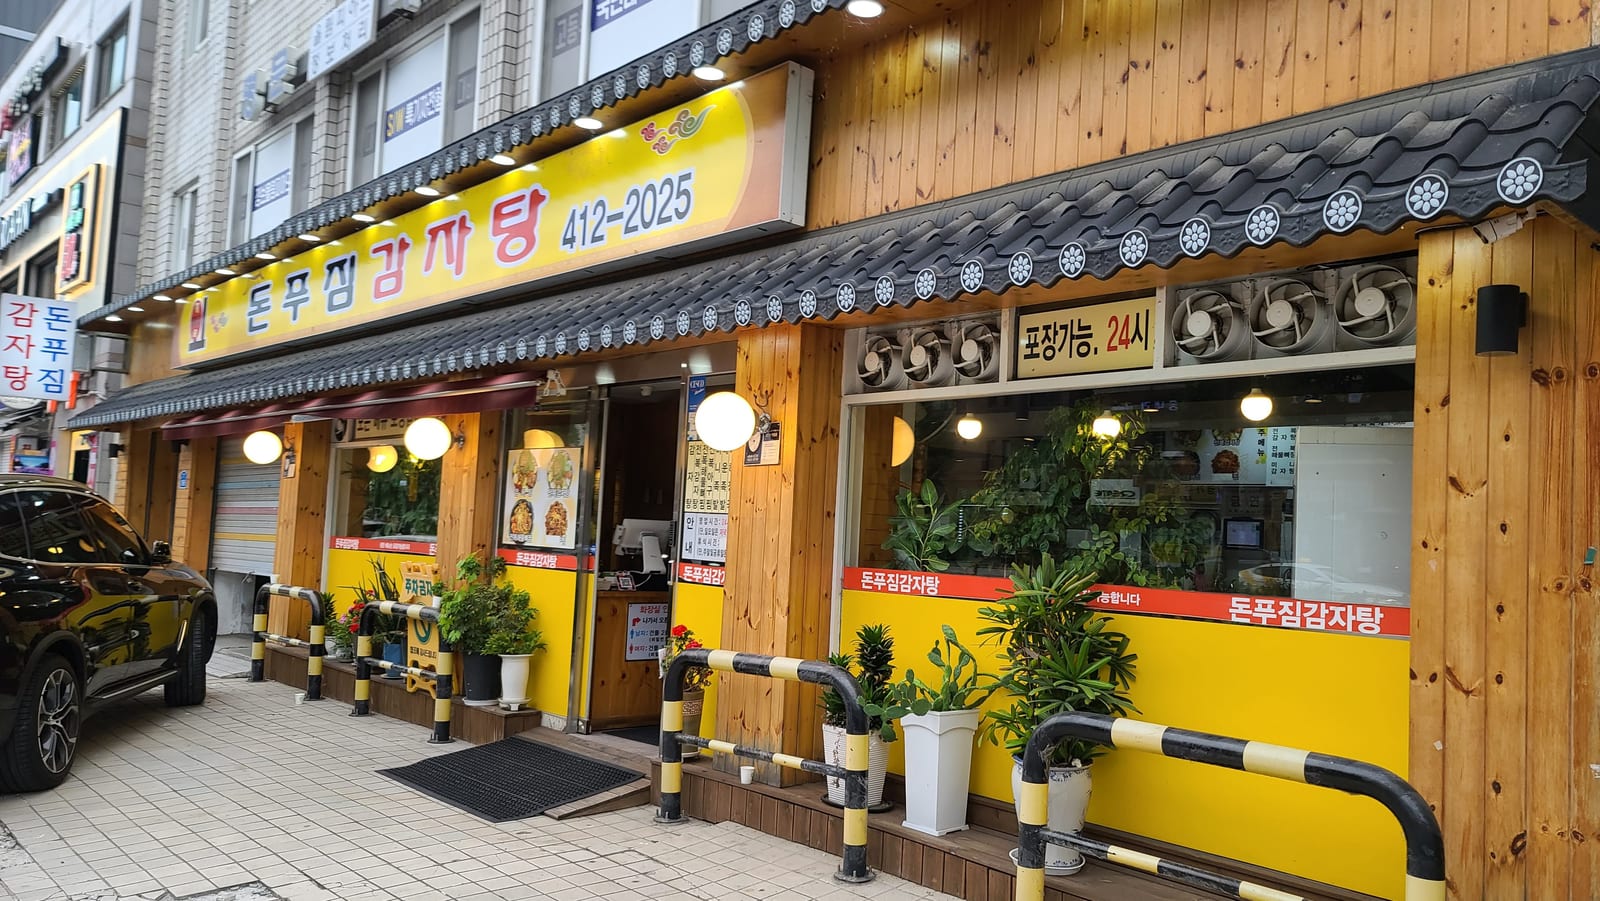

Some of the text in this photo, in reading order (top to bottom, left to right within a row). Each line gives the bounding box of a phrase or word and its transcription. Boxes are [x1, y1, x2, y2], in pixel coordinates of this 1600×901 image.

[562, 172, 692, 250] 412-2025
[2, 302, 38, 392] 감자탕
[38, 306, 72, 393] 돈푸짐
[516, 552, 558, 569] 돈푸짐감자탕
[861, 571, 940, 596] 돈푸짐감자탕
[1096, 591, 1141, 607] 능합니다
[1229, 597, 1384, 635] 돈푸짐감자탕
